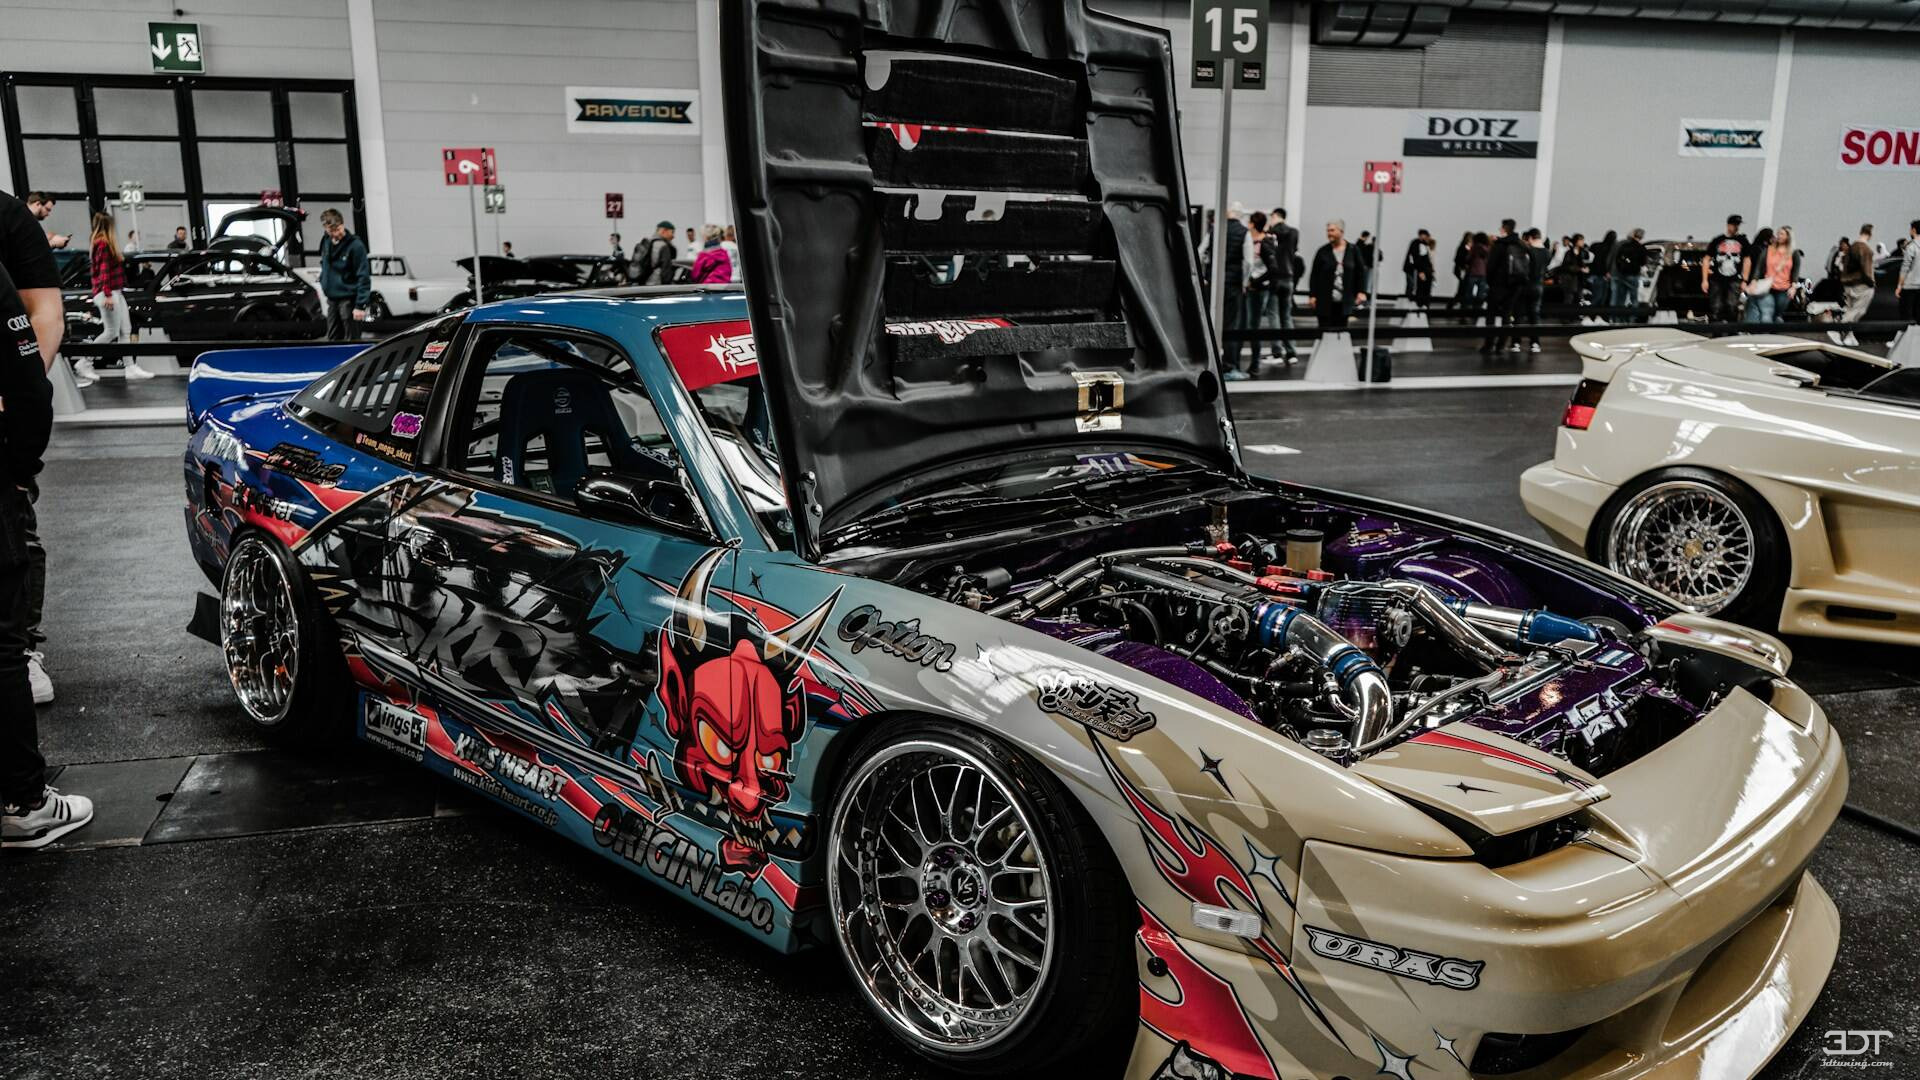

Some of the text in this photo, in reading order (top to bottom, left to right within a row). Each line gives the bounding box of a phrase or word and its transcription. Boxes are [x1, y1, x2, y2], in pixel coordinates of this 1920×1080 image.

[1205, 7, 1258, 53] 15
[584, 104, 683, 119] RAVENOL
[1428, 117, 1519, 139] DOTZ
[1441, 141, 1504, 152] WHEELS
[122, 189, 141, 203] 20
[486, 193, 504, 207] 19
[607, 201, 622, 212] 27
[838, 604, 957, 672] Option
[1304, 926, 1485, 991] URAS
